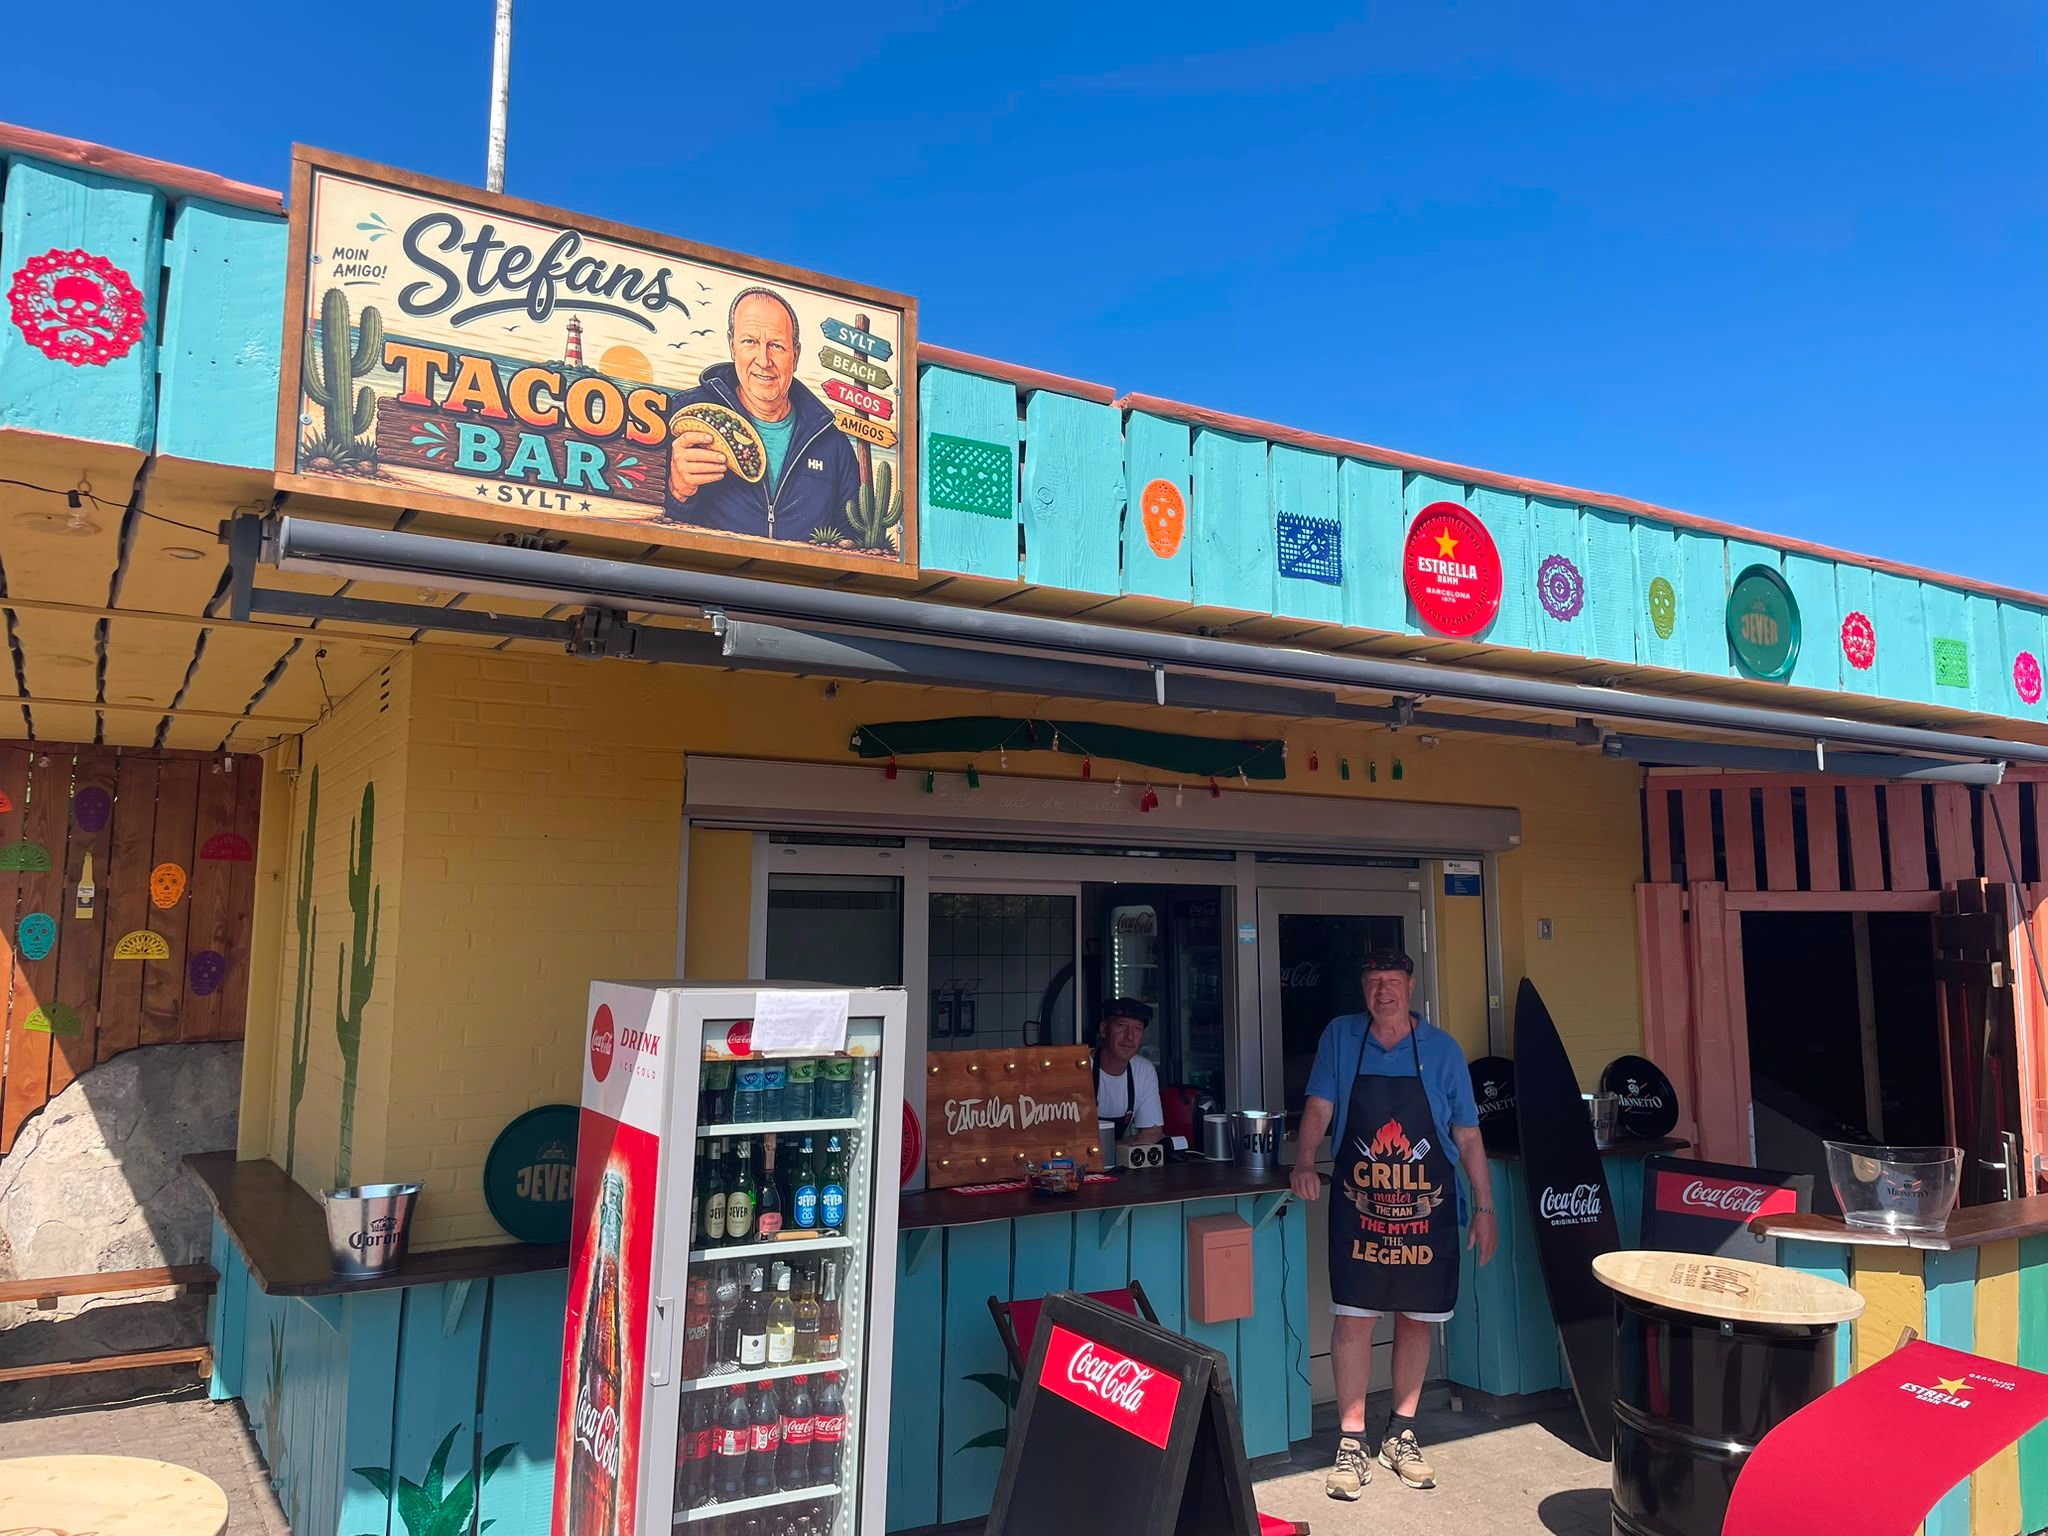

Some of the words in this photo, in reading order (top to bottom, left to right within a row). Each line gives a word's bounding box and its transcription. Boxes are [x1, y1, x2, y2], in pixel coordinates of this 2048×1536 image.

[332, 247, 368, 264] MOIN
[398, 212, 691, 320] Stefans
[332, 263, 388, 280] AMIGO!
[838, 329, 876, 352] SYLT
[832, 353, 878, 381] BEACH
[382, 339, 671, 446] TACOS
[838, 385, 882, 412] TACOS
[838, 416, 886, 442] AMIGOS
[453, 420, 612, 494] BAR
[807, 458, 824, 471] HH
[497, 485, 573, 512] SYLT
[1417, 556, 1478, 580] ESTRELLA
[1437, 575, 1459, 585] DAMM
[1426, 586, 1471, 599] BARCELONA
[1742, 613, 1778, 646] JEVER
[1117, 911, 1155, 935] Coca-Cola
[620, 1027, 660, 1056] DRINK
[620, 1060, 633, 1073] ICE
[636, 1066, 656, 1080] COLD
[944, 1095, 1015, 1136] Estrella
[1018, 1094, 1081, 1130] Damm
[1244, 1133, 1273, 1154] JEVE
[1353, 1161, 1432, 1190] GRILL
[798, 1194, 816, 1207] JEVER
[823, 1194, 842, 1206] JEVER
[1373, 1188, 1413, 1204] master
[1540, 1183, 1601, 1219] Coca-Cola
[1682, 1181, 1766, 1214] Coca-Cola
[729, 1206, 749, 1218] JEVER
[1375, 1204, 1391, 1216] THE
[1392, 1206, 1413, 1217] MAN
[1551, 1218, 1579, 1226] ORIGINAL
[1360, 1215, 1386, 1233] THE
[1388, 1219, 1429, 1235] MYTH
[1352, 1239, 1434, 1265] LEGEND
[1382, 1236, 1404, 1246] THE
[1067, 1341, 1156, 1413] Coca-Cola
[1899, 1382, 1972, 1409] ESTRELLA
[575, 1384, 620, 1480] Coca-Cola
